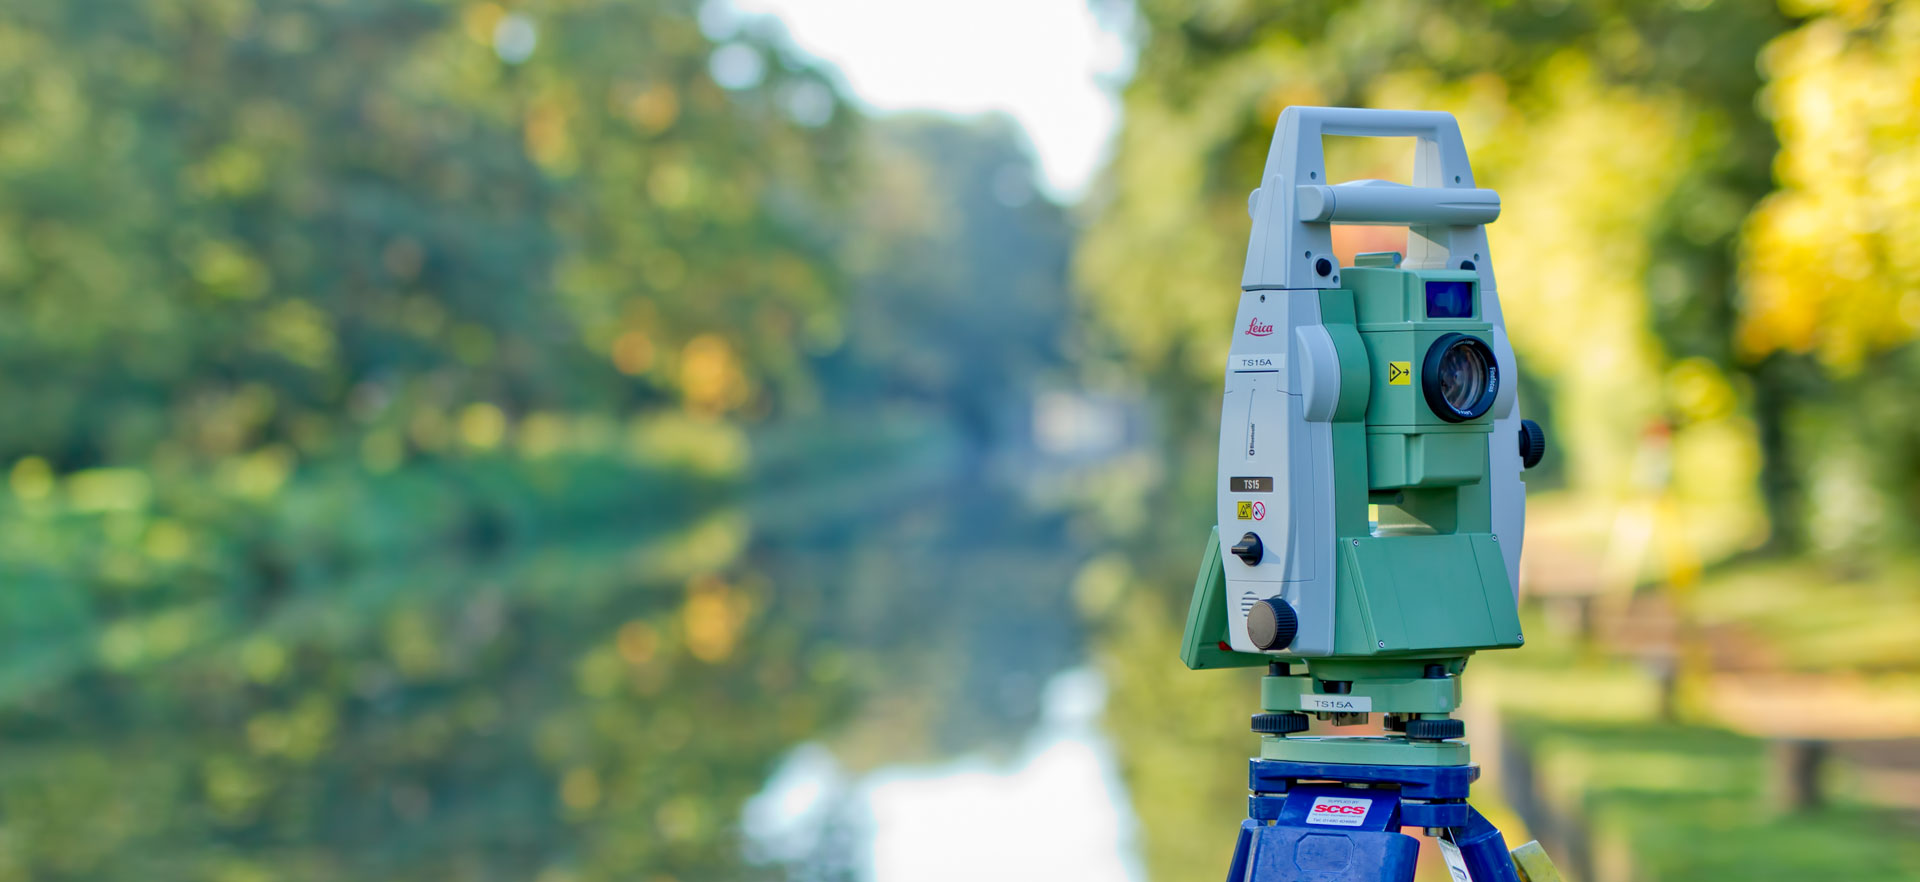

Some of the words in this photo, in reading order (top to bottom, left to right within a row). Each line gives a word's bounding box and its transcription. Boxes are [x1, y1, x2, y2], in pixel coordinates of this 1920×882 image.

[1245, 317, 1273, 337] Leica
[1244, 480, 1260, 489] TS15
[1315, 700, 1353, 708] TS15A
[1314, 804, 1365, 815] SCCS
